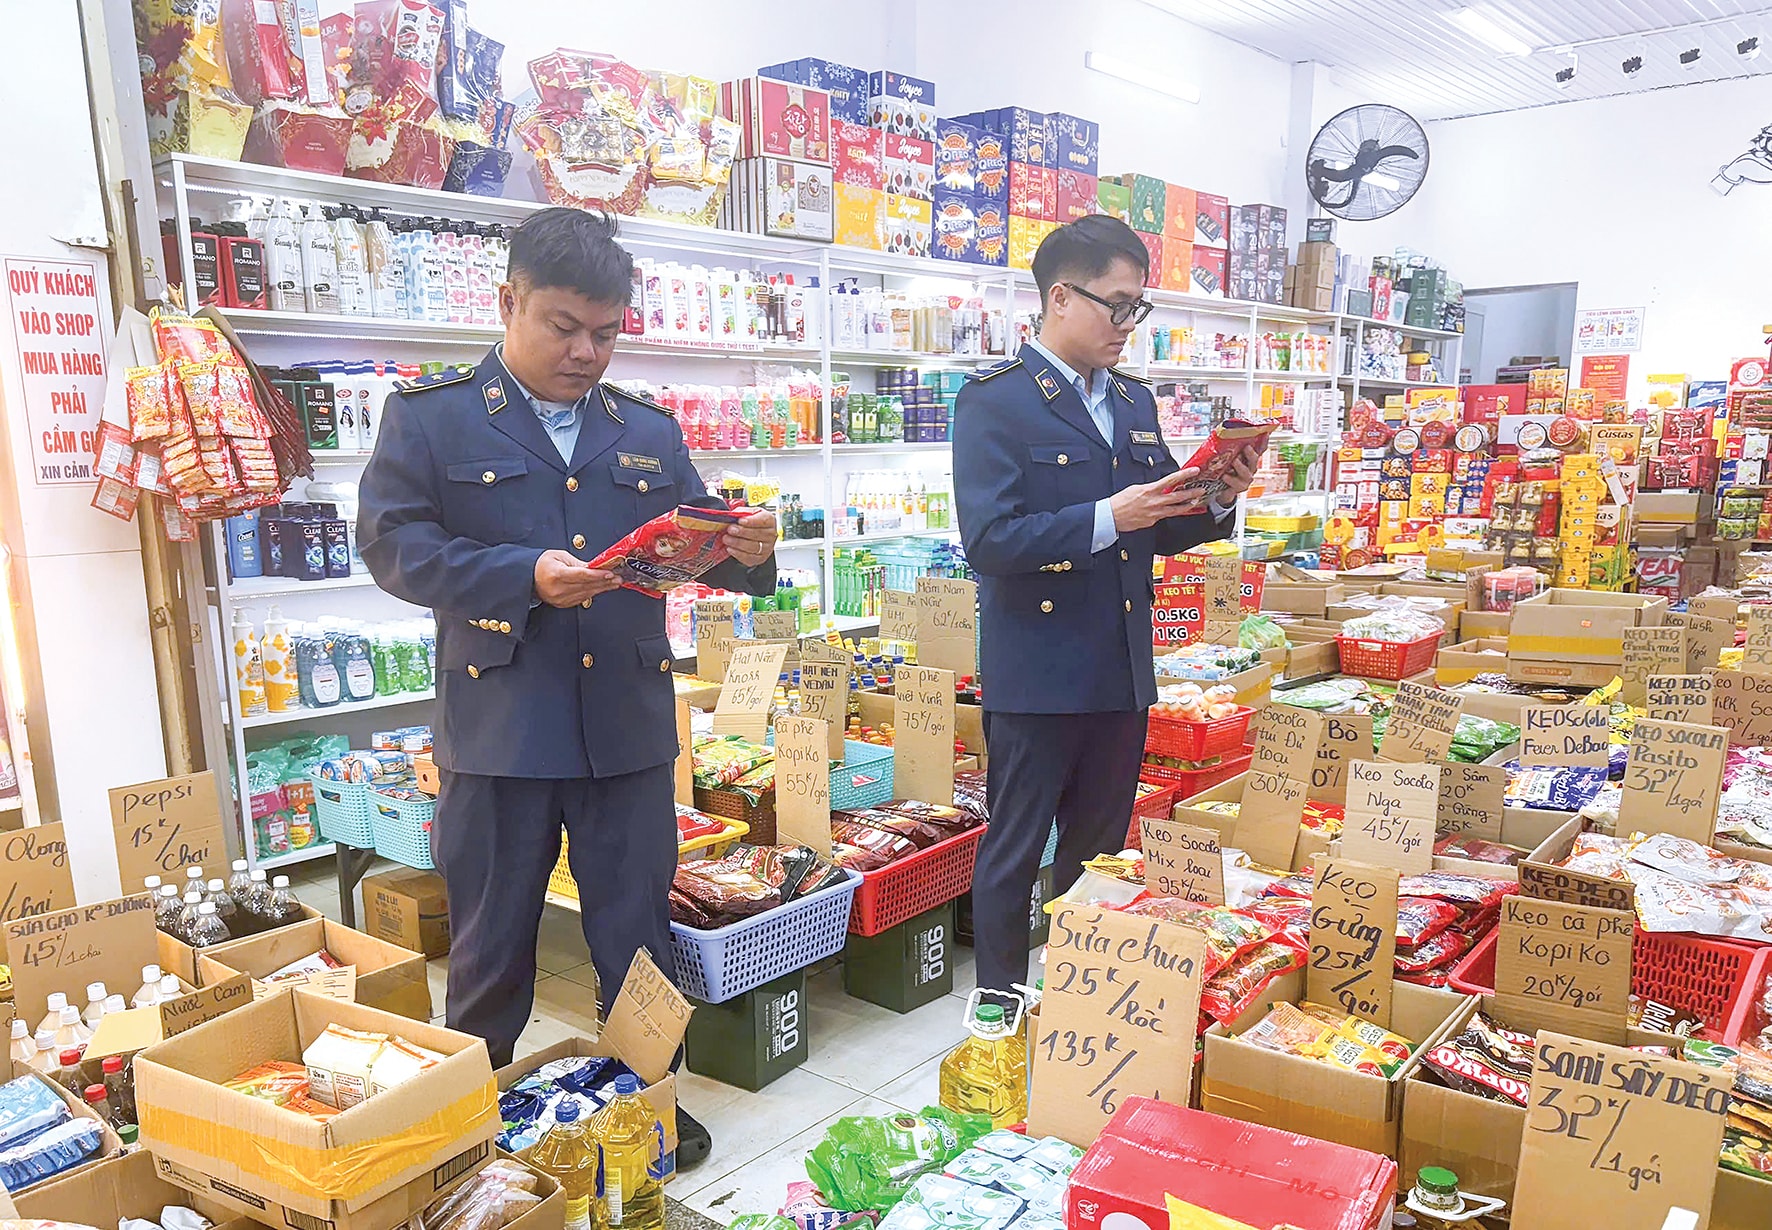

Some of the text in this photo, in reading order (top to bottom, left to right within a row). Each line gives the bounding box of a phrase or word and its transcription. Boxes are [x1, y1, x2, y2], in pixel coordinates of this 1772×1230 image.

[942, 149, 969, 162] OREO
[979, 158, 1006, 170] OREO
[979, 226, 1003, 238] OREO
[274, 238, 292, 250] Beauty
[311, 241, 328, 252] Beauty
[234, 258, 261, 267] ROMANO
[9, 266, 95, 298] QUÝ KHÁCH
[20, 306, 94, 337] VÀO SHOP
[23, 348, 102, 376] MUA HÀNG
[51, 384, 87, 414] PHẢI
[42, 424, 96, 454] CẦM GI
[1597, 428, 1634, 440] Custas
[40, 461, 89, 479] XIN CẢM
[1157, 609, 1199, 621] 0.5KG
[1424, 688, 1461, 708] SOCOLA
[1328, 719, 1358, 742] Bò
[1633, 723, 1662, 744] KẸO
[1664, 729, 1723, 750] SOCOLA
[1632, 744, 1698, 769] Pasito
[1463, 768, 1490, 783] Sâm
[1367, 791, 1402, 816] Nga
[1148, 850, 1175, 869] Mix
[1316, 863, 1377, 904] Kẹo
[1522, 866, 1570, 889] KẸO
[1508, 901, 1549, 929] Kẹo
[928, 924, 944, 981] 900
[213, 983, 247, 1002] Cam
[780, 988, 799, 1054] 900
